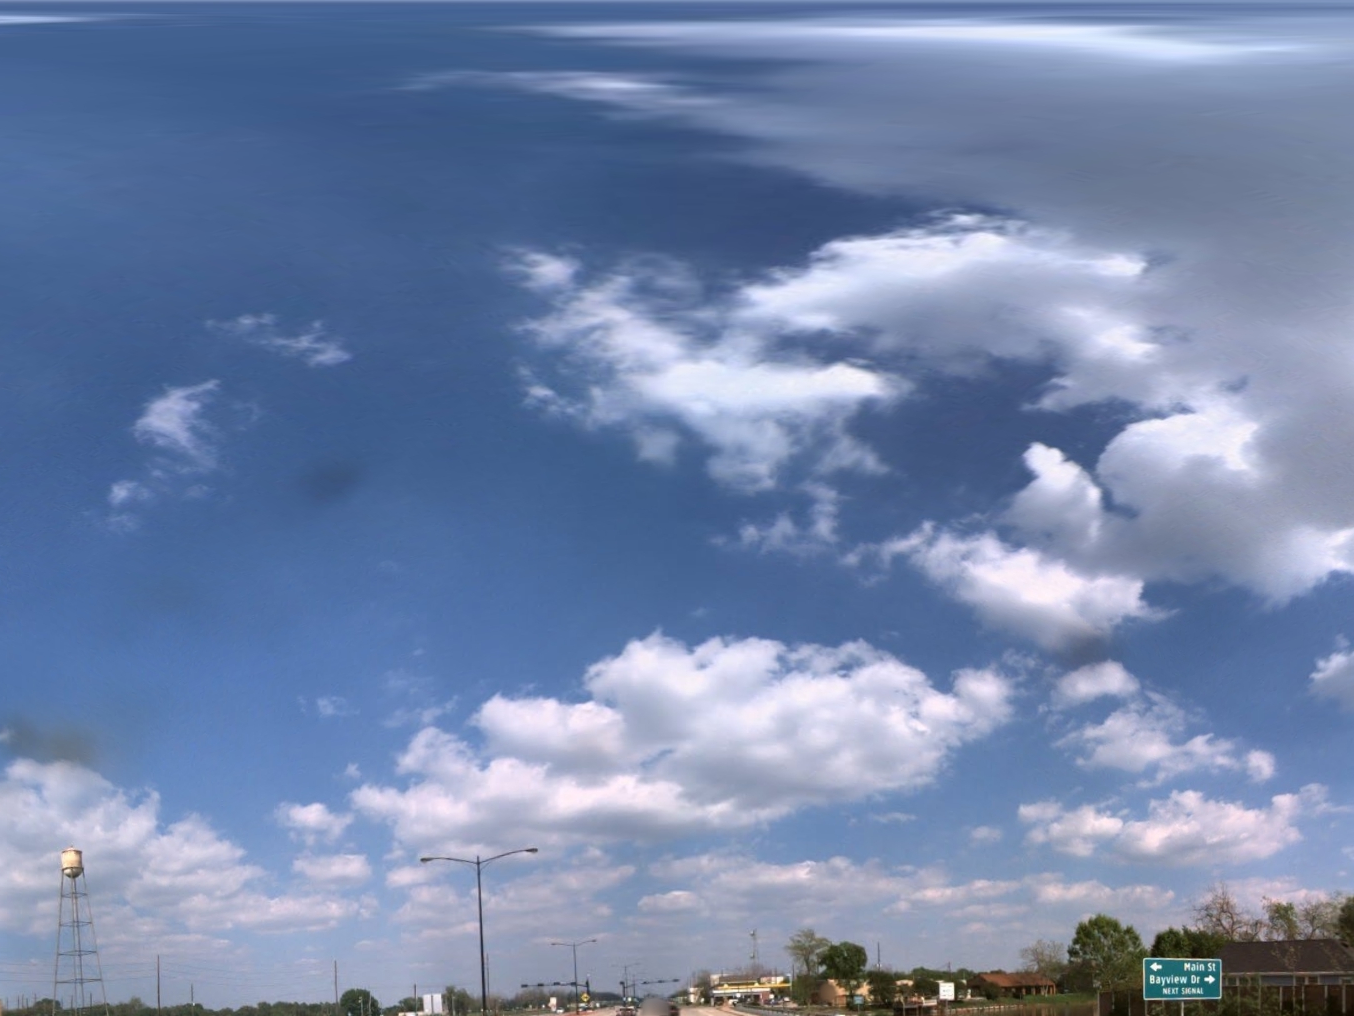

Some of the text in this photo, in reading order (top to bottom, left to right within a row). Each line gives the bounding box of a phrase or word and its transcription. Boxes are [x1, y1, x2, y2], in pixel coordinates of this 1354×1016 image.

[1184, 962, 1216, 972] Main St
[1149, 975, 1201, 986] Bayview Dr
[1181, 987, 1204, 995] SIGNAL
